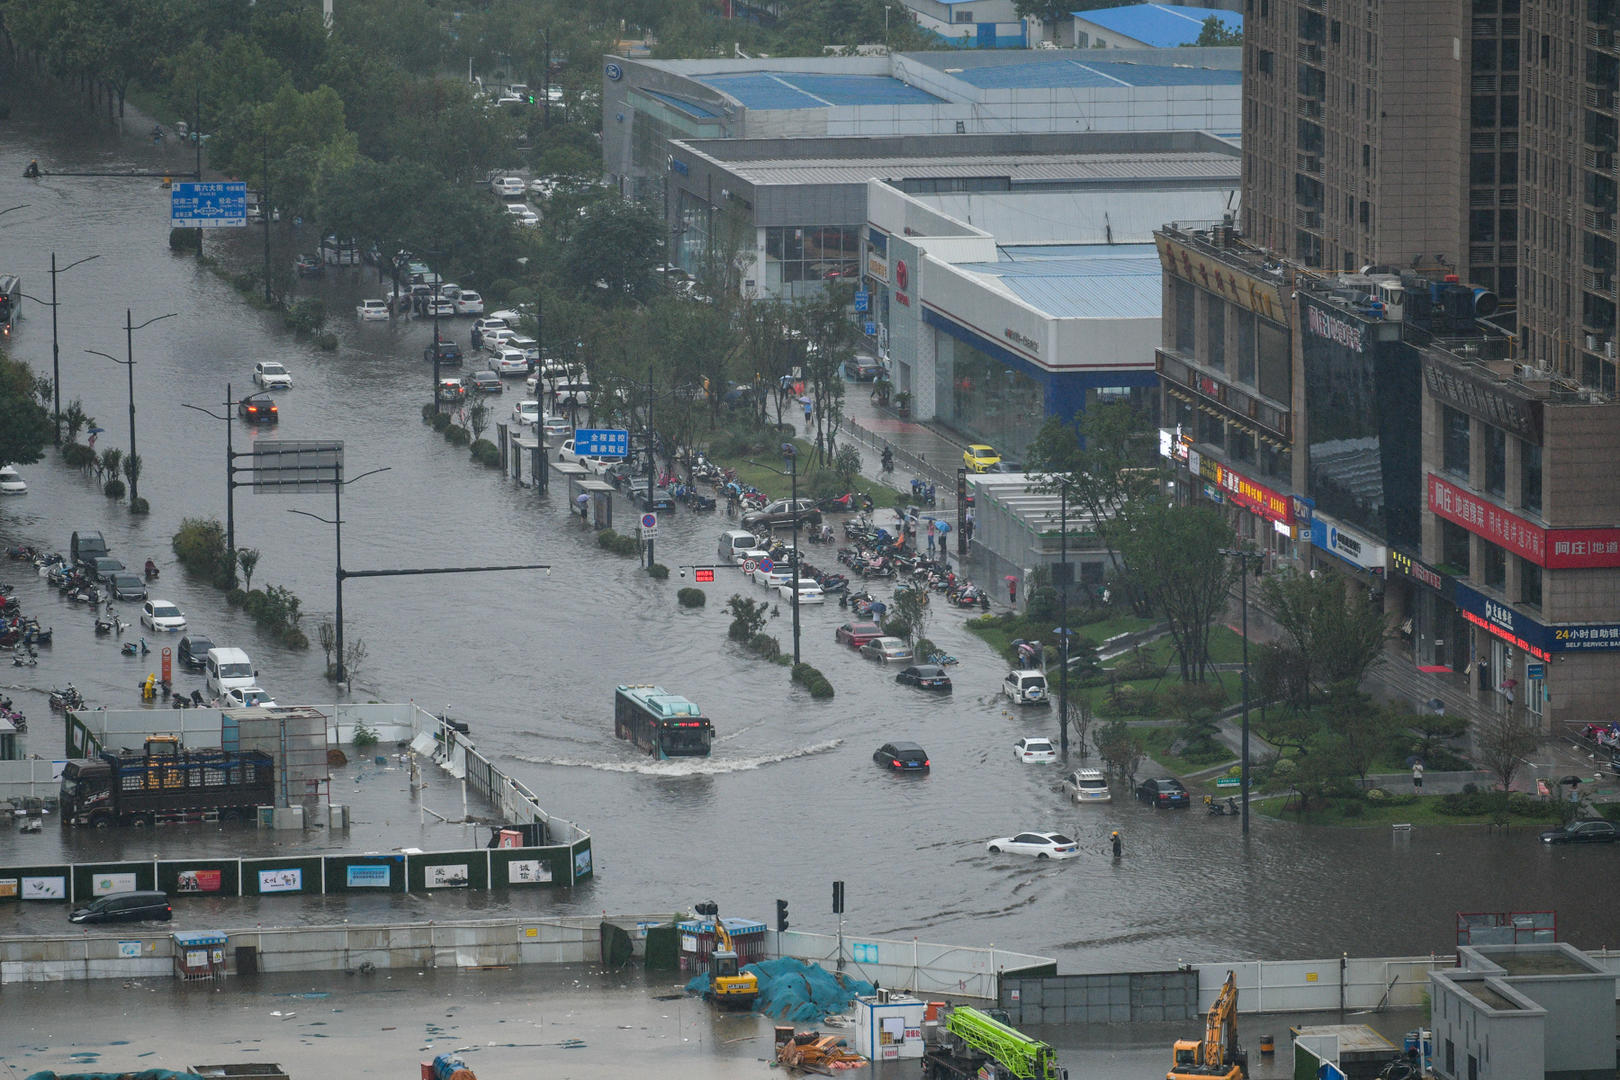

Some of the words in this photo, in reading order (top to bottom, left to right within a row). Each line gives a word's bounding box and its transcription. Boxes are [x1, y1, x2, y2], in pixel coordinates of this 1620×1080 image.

[1555, 542, 1586, 556] 阿庄
[1592, 540, 1618, 554] 地道
[746, 561, 754, 570] 60
[1556, 628, 1620, 640] 24小时自助银
